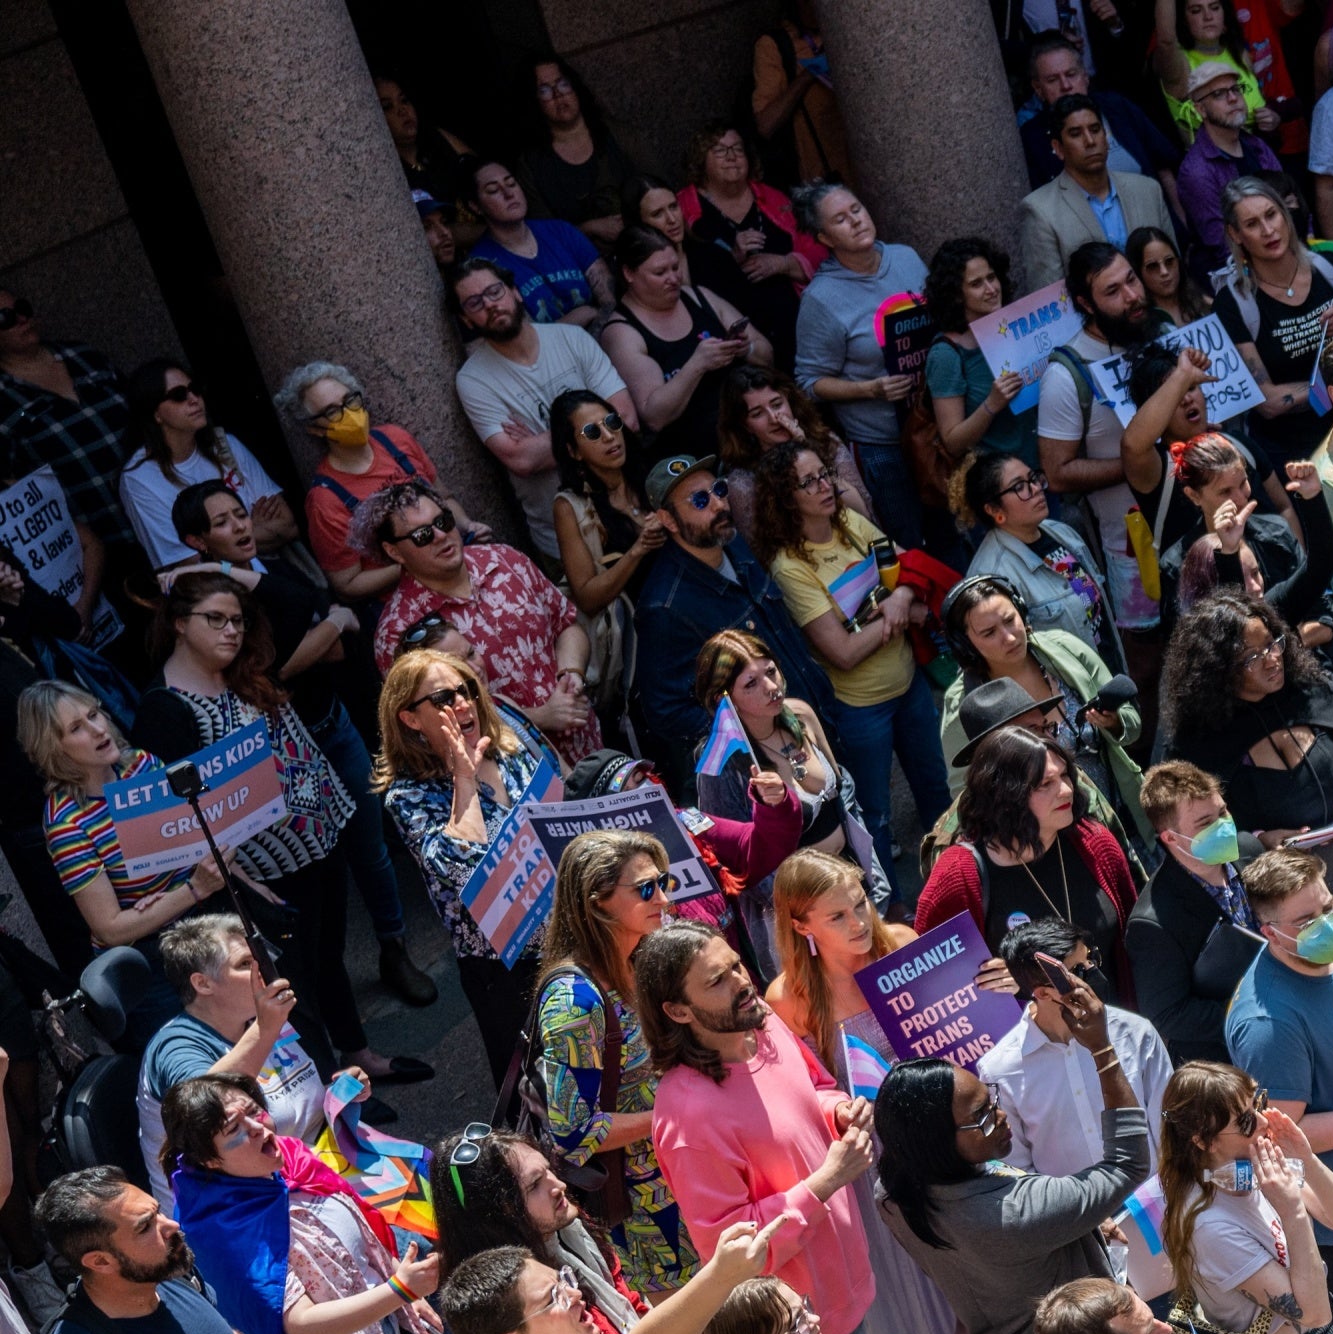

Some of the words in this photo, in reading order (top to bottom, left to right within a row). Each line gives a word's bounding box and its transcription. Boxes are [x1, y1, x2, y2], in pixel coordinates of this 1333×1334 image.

[1008, 302, 1061, 340] TRANS
[896, 336, 912, 355] TO
[1035, 331, 1052, 354] IS
[6, 498, 25, 518] to
[24, 480, 43, 507] all
[28, 549, 47, 570] &
[41, 529, 74, 562] laws
[50, 564, 84, 601] ederal
[114, 783, 153, 811] LET
[157, 760, 225, 798] TNS
[226, 731, 266, 766] KIDS
[160, 803, 223, 839] GROW
[223, 785, 251, 819] UP
[509, 834, 531, 865] TO
[876, 934, 966, 995] ORGANIZE
[887, 992, 916, 1016] TO
[899, 982, 980, 1039] PROTECT
[910, 1016, 975, 1057] TRANS
[943, 1033, 998, 1068] XANS
